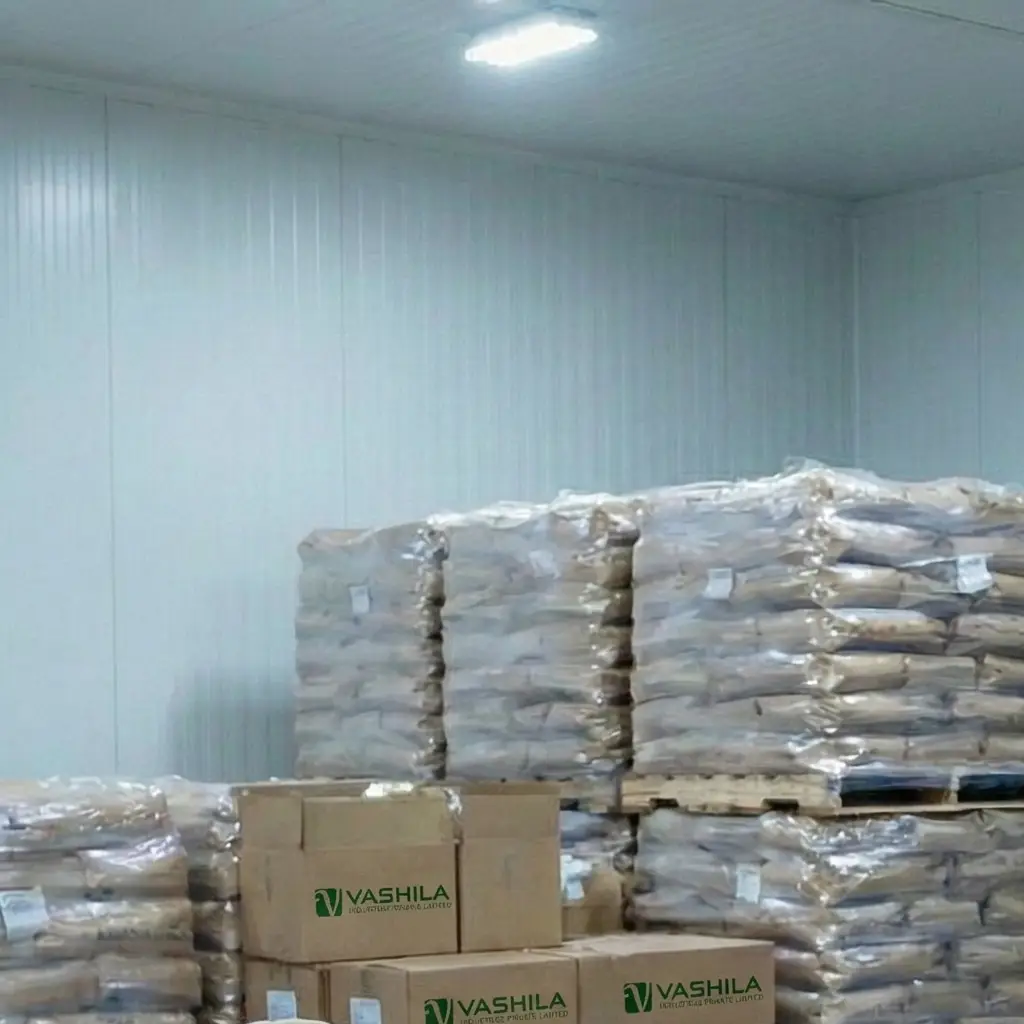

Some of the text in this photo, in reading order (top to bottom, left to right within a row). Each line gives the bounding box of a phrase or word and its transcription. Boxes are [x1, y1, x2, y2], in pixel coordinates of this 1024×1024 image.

[345, 884, 450, 905] VASHILA
[656, 975, 763, 1000] VASHILA
[457, 991, 567, 1016] VASHILA
